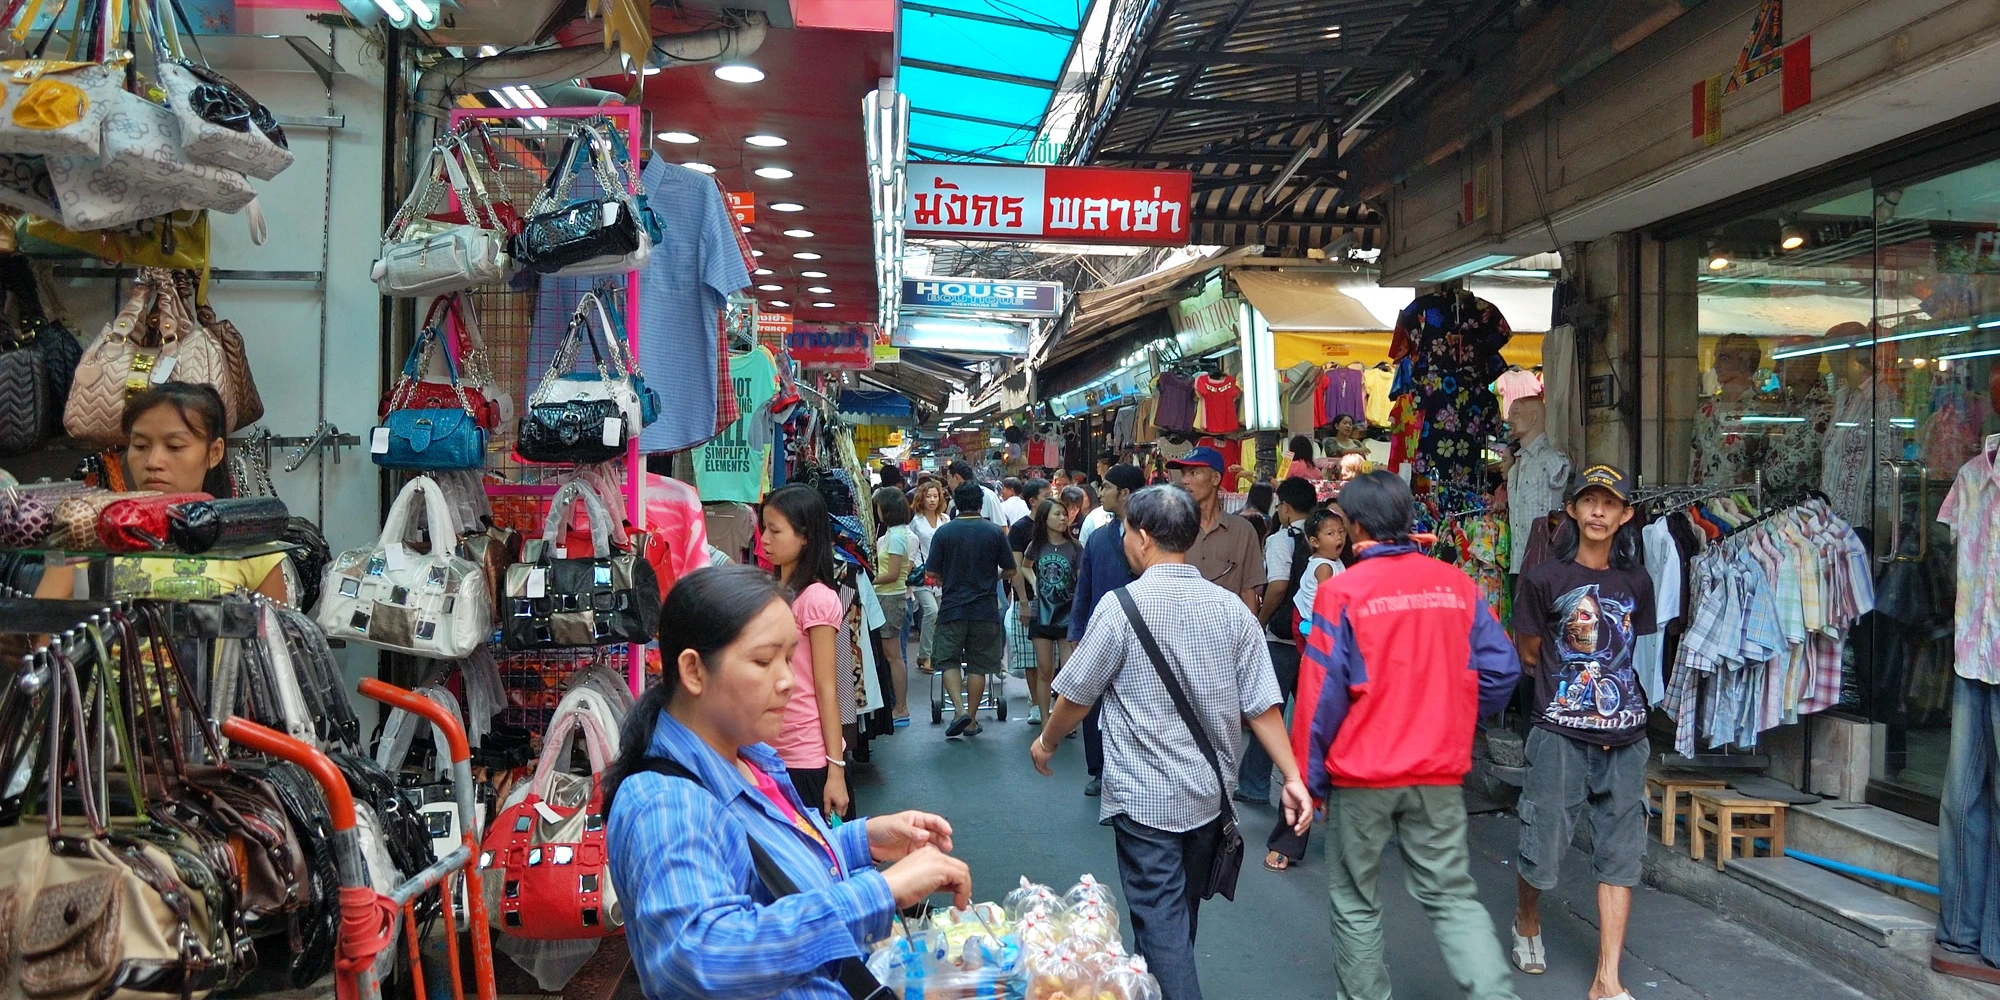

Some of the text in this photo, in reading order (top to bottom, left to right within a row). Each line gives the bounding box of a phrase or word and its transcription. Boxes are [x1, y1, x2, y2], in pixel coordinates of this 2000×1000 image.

[914, 177, 1182, 233] มังกร พลาซ่า
[917, 282, 1037, 299] HOUSE
[927, 293, 1024, 306] BOUTIQUE
[733, 377, 752, 397] OT
[981, 440, 990, 449] 10
[705, 446, 750, 459] SIMPLIFY
[705, 460, 750, 472] ELEMENTS
